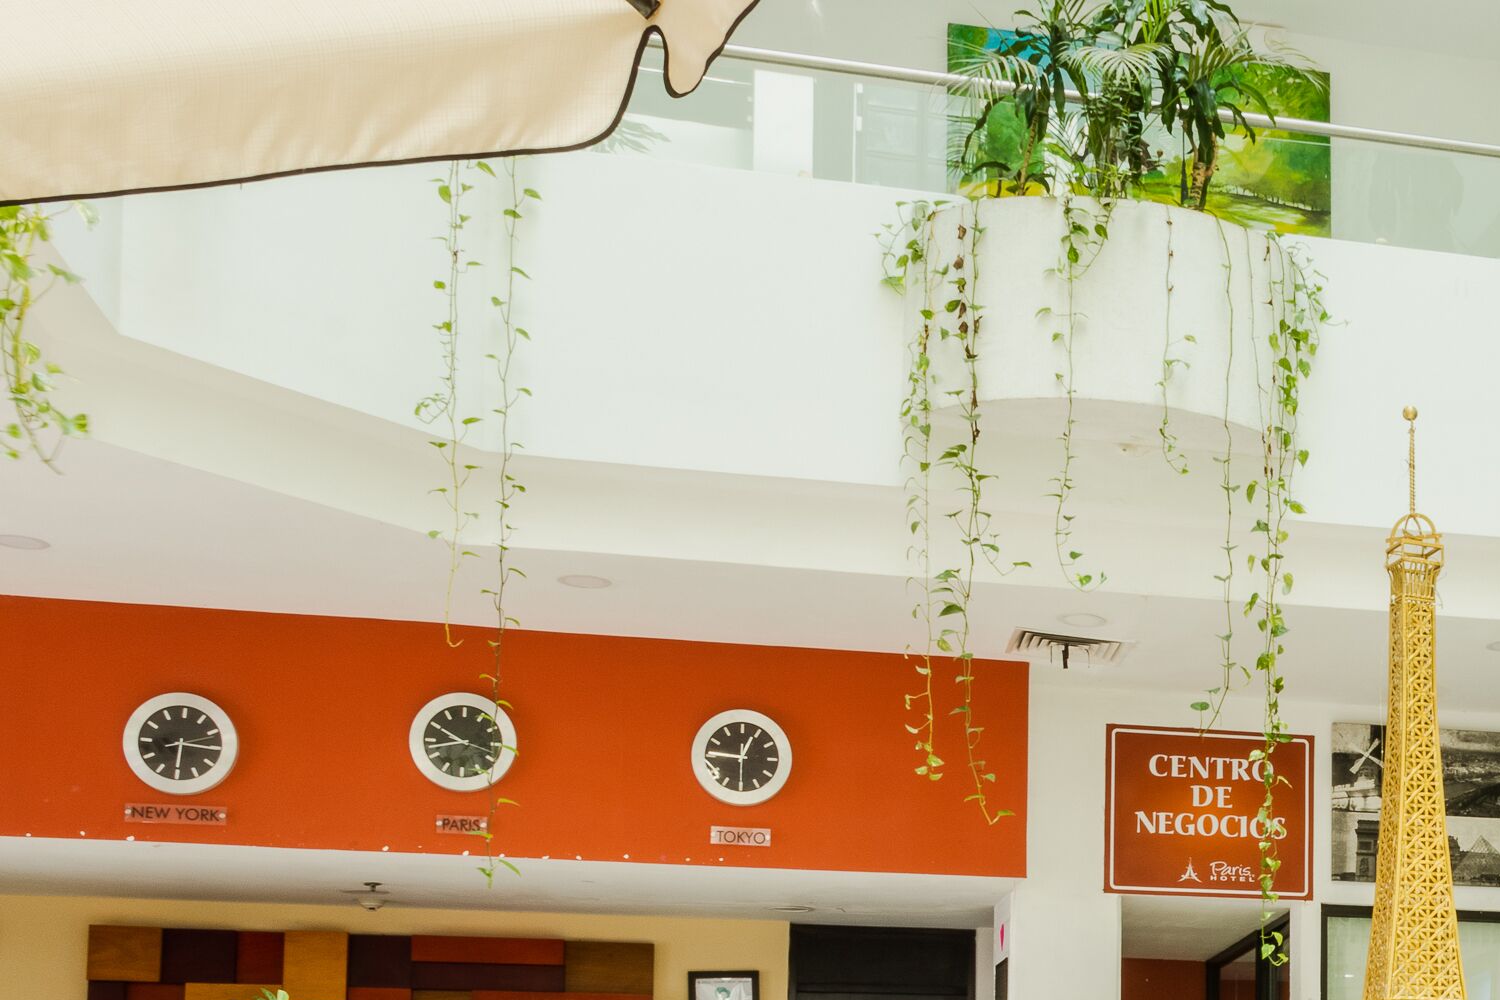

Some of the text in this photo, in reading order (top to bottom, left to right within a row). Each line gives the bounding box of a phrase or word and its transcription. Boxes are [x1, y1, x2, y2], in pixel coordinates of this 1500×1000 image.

[1149, 754, 1274, 782] CENTRO
[1190, 784, 1233, 809] DE
[131, 806, 220, 821] NEW YORK
[442, 818, 481, 831] PARIS
[1134, 810, 1288, 840] NEGOCIOS
[716, 830, 766, 845] TOKYO
[1209, 860, 1252, 877] Paris
[1210, 874, 1256, 883] HOTEL
